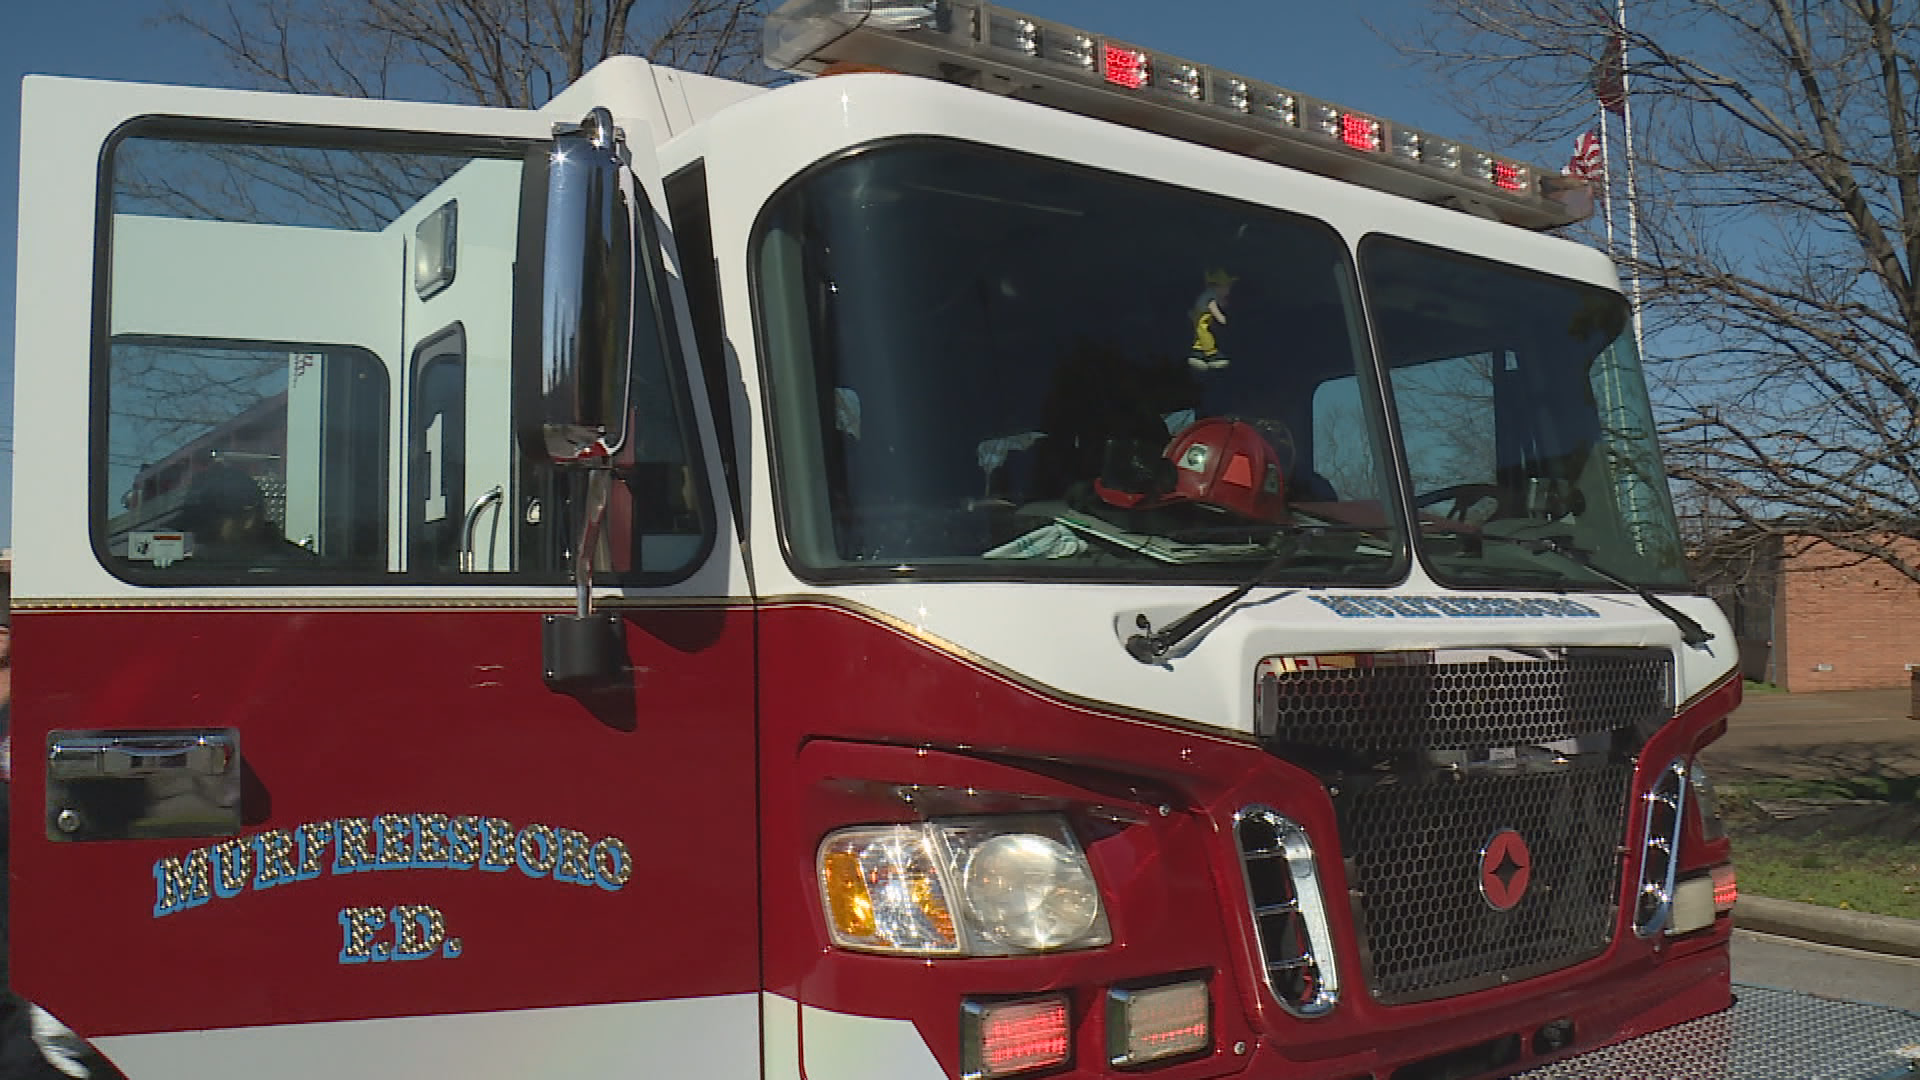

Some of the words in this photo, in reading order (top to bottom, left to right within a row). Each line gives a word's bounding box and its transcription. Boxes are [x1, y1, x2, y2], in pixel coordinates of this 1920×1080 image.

[425, 413, 447, 522] 1
[153, 813, 633, 918] MURFREESBORO
[338, 904, 463, 965] F.D.
